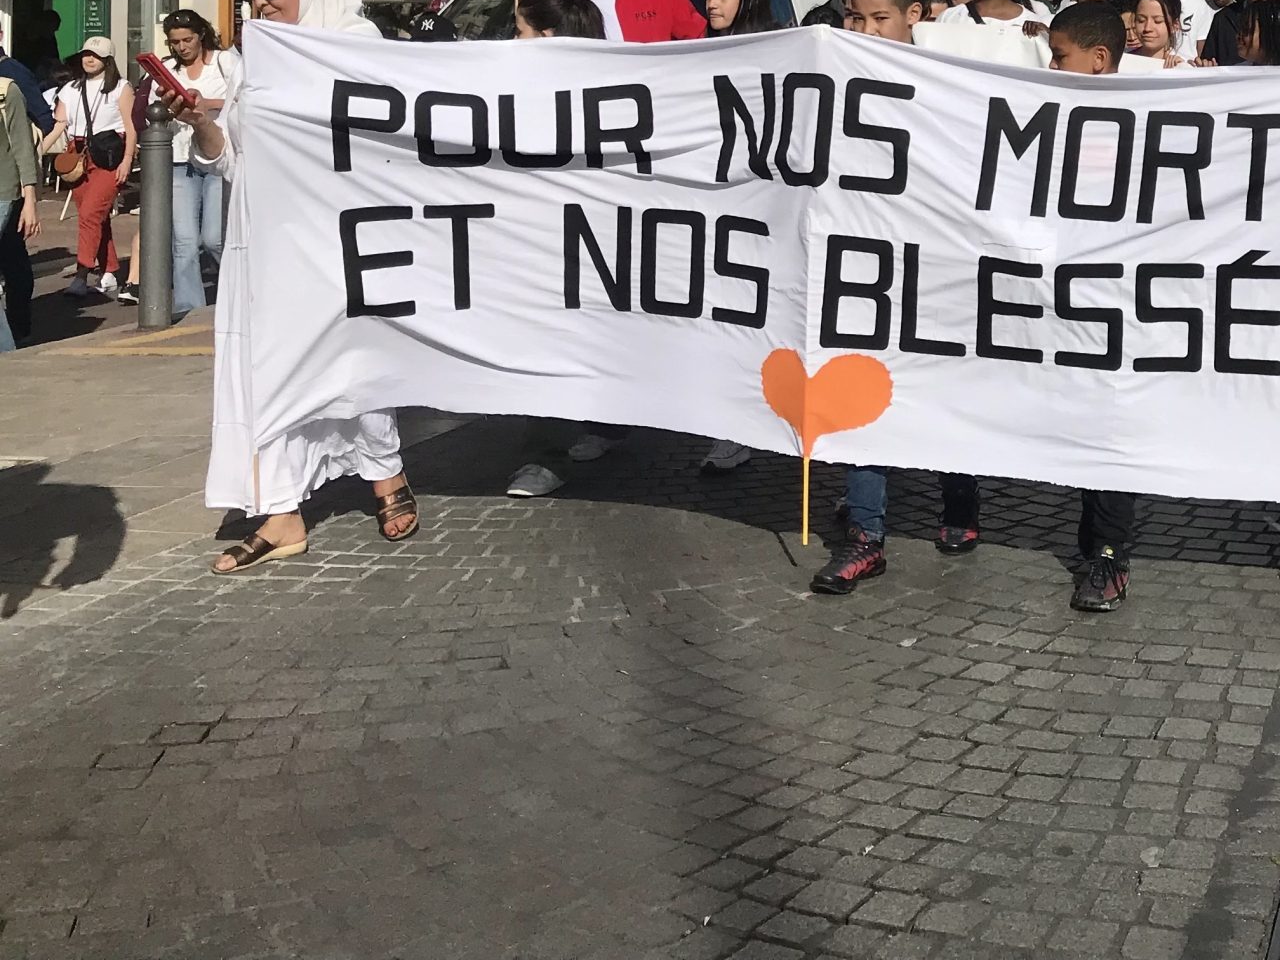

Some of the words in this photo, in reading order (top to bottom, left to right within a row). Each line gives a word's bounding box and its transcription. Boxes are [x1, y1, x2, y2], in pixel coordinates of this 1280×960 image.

[330, 79, 654, 175] POUR
[713, 72, 915, 195] NOS
[339, 203, 495, 319] ET
[563, 203, 770, 330] NOS
